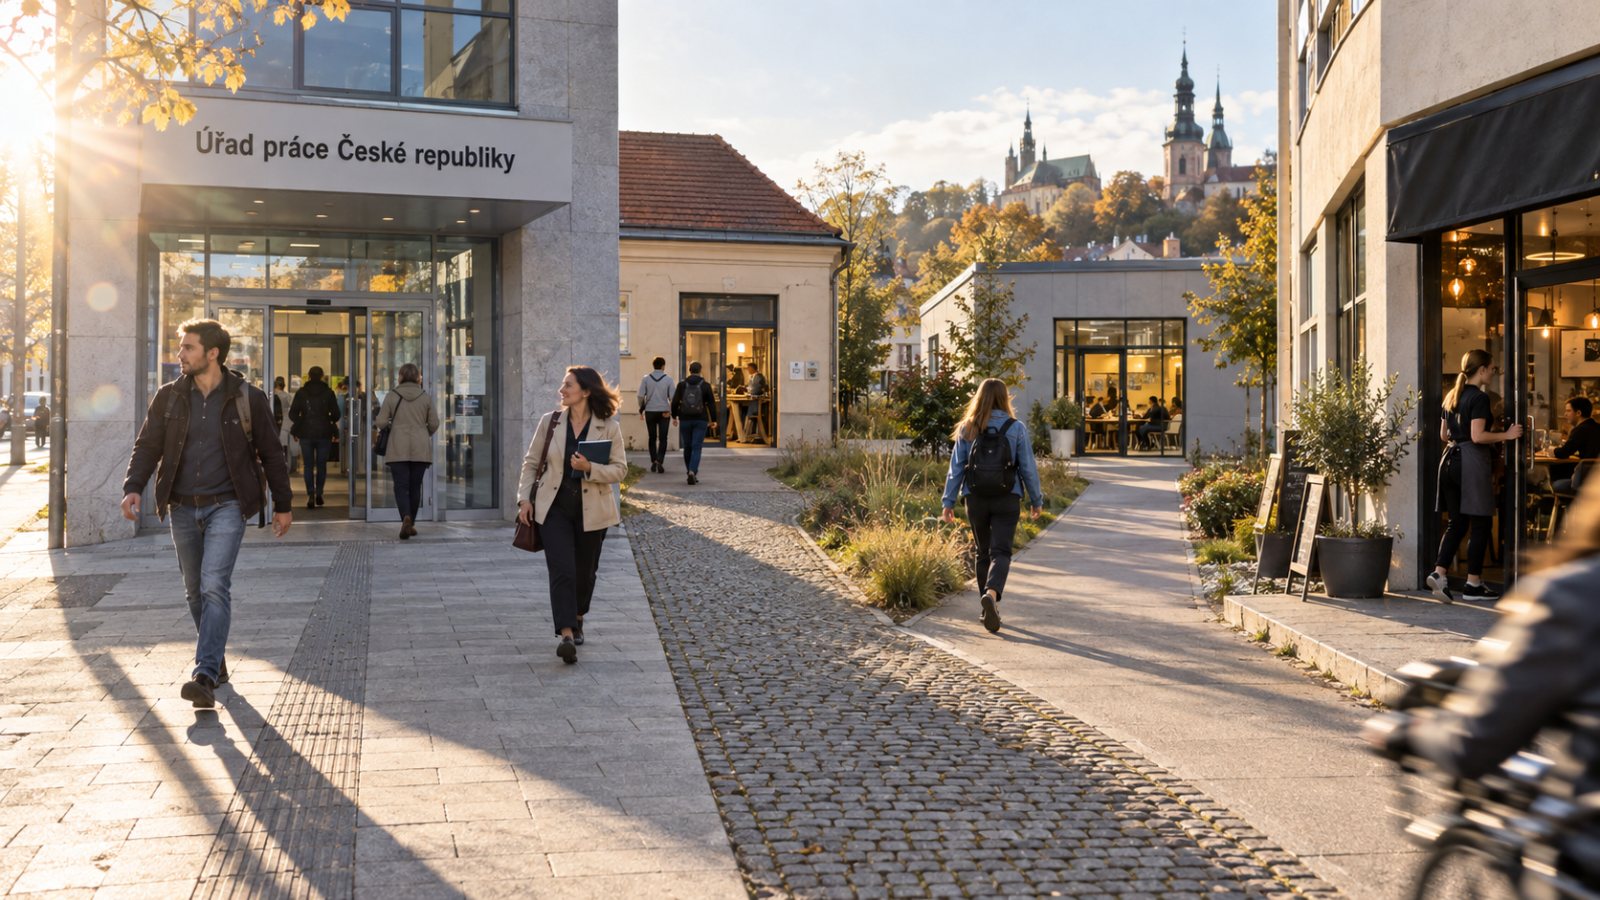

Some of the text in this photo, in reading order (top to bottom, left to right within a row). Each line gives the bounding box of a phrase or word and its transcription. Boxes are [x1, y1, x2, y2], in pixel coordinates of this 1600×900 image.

[196, 126, 515, 173] Úřad práce České republiky
